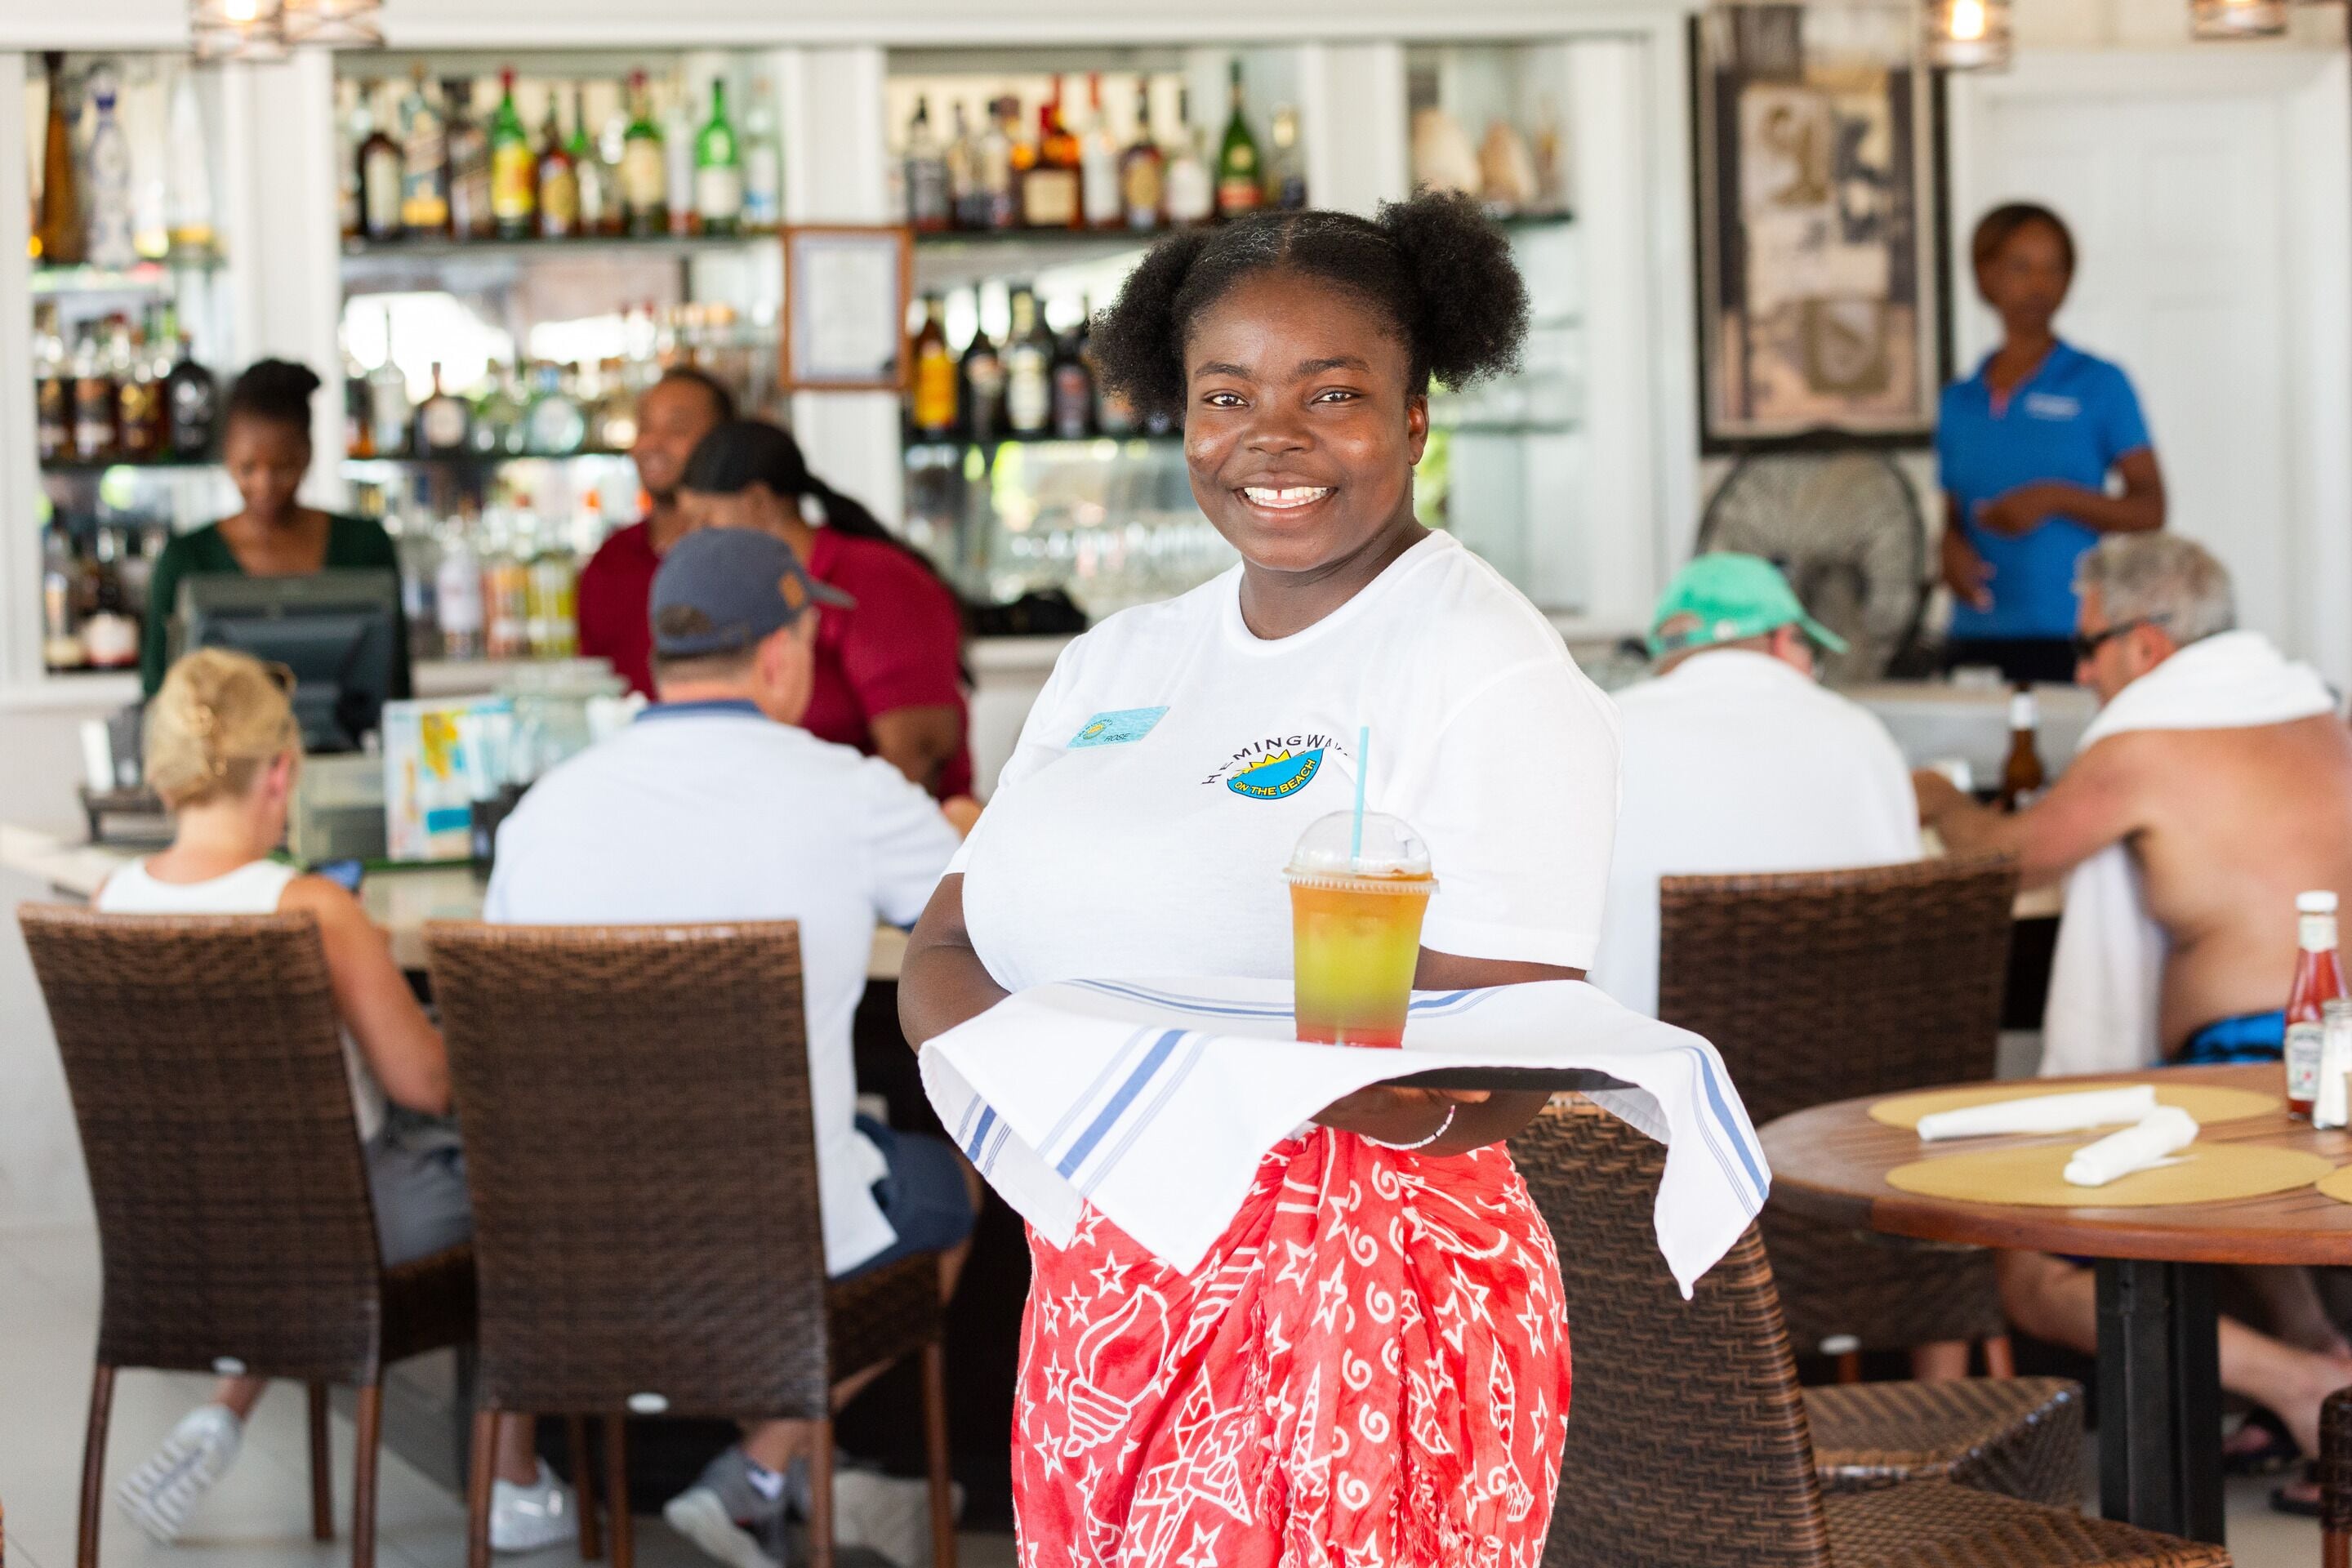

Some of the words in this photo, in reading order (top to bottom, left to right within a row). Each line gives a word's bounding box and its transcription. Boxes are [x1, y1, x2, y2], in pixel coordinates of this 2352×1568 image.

[1103, 733, 1130, 742] ROSE
[1234, 781, 1249, 792] ON
[1250, 786, 1276, 796] THE
[1280, 759, 1316, 795] BEACH
